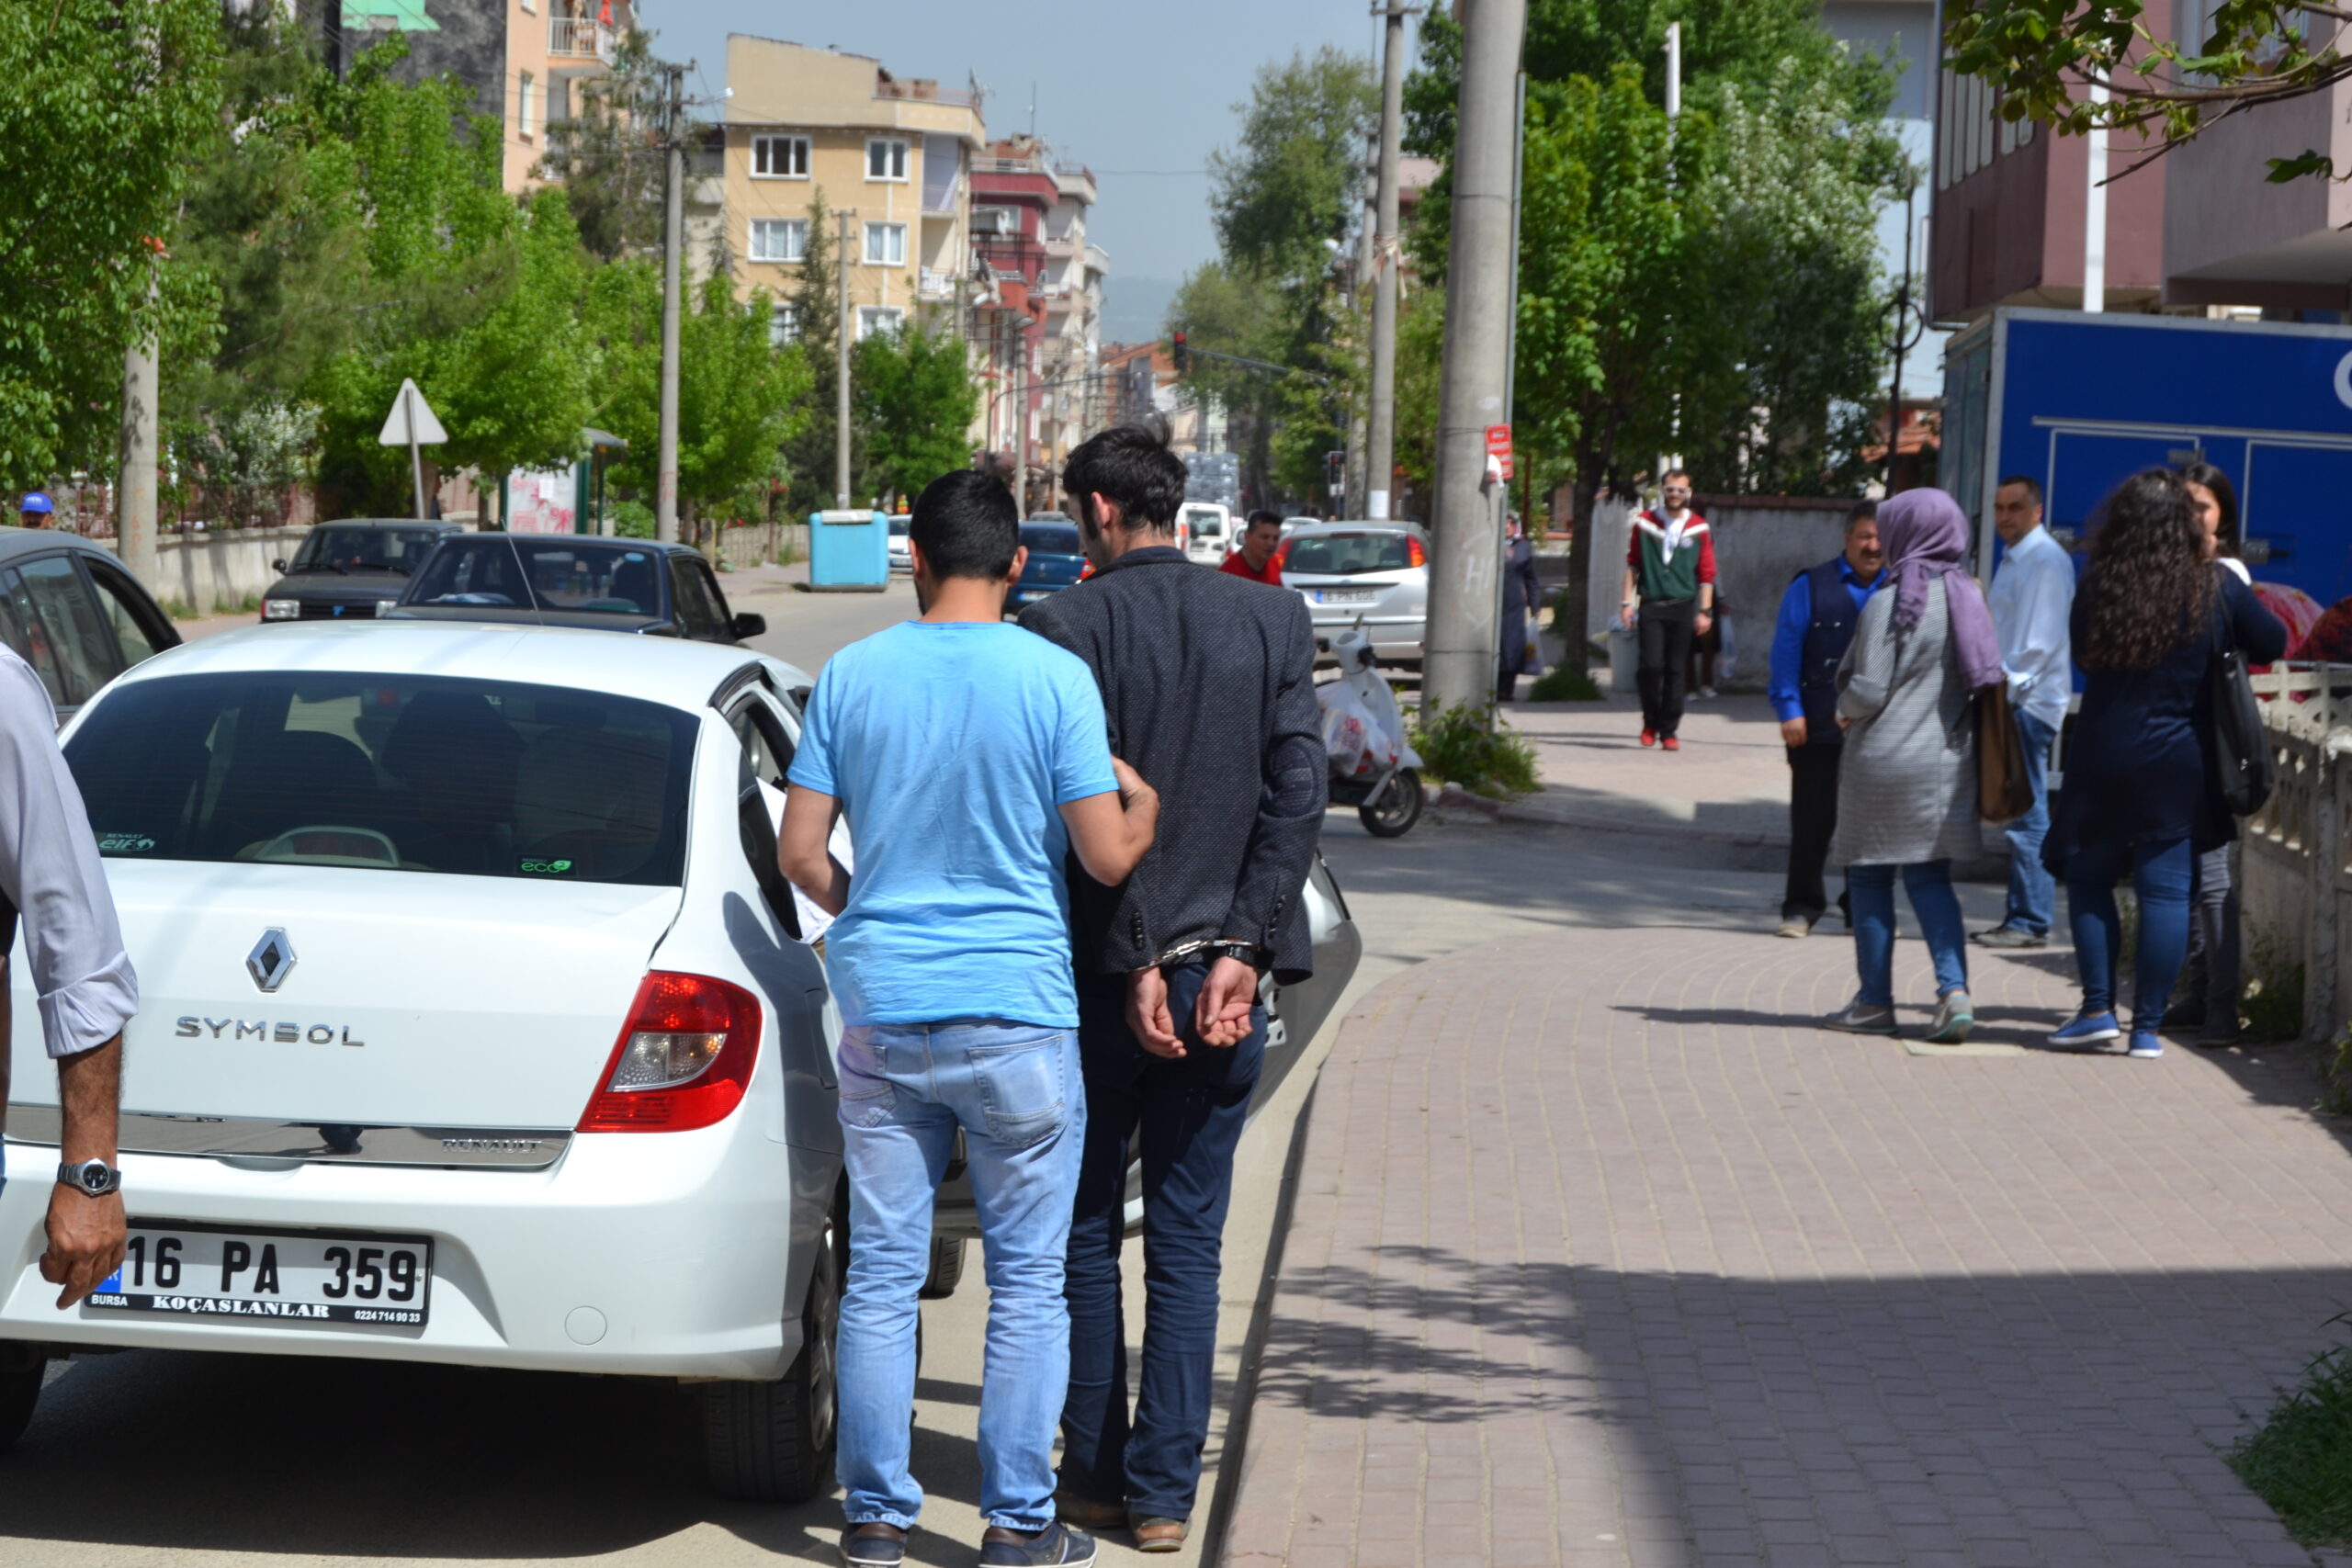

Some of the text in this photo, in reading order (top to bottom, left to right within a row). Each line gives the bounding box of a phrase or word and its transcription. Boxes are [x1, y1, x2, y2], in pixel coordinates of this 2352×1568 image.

[98, 839, 137, 850] elf
[175, 1015, 365, 1047] SYMBOL
[442, 1138, 542, 1153] RENAULT
[128, 1235, 417, 1302] 16 PA 359
[91, 1294, 129, 1306] BURSA
[152, 1295, 330, 1318] KOÇASLANLAR
